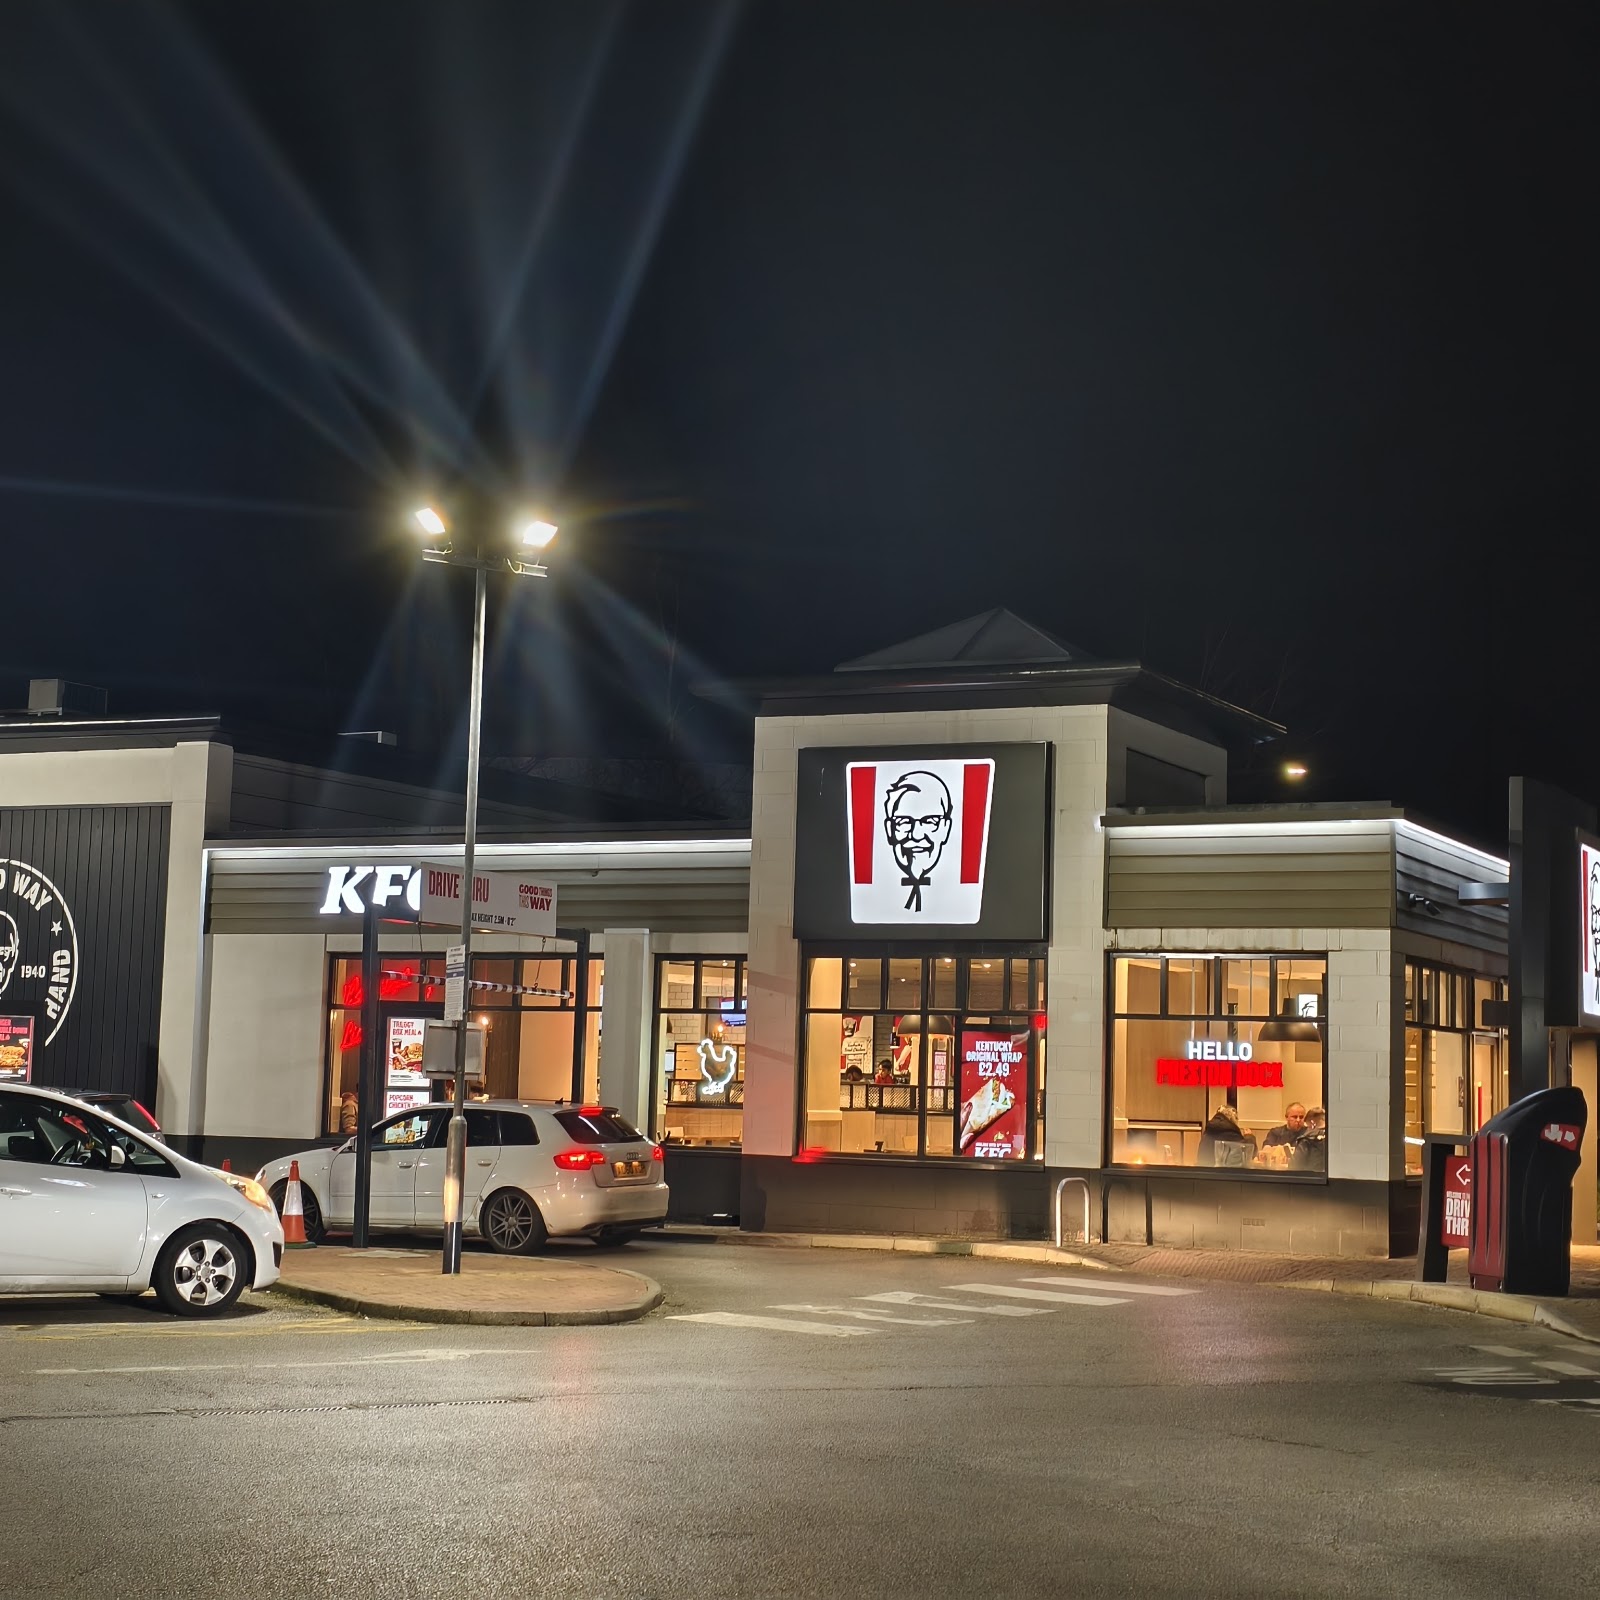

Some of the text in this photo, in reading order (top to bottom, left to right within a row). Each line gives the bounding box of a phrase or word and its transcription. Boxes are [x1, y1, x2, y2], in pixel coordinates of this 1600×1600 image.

[12, 871, 53, 911] WAY
[428, 870, 490, 903] DRIVE RU
[518, 884, 539, 895] GOOD
[530, 897, 552, 911] WAY
[21, 965, 46, 979] 1940
[45, 949, 71, 1020] HAND
[975, 1040, 1013, 1052] KENTUCKY
[1187, 1040, 1253, 1061] HELLO
[965, 1051, 1023, 1063] ORIGINAL WRAP
[978, 1062, 1010, 1077] £2.49
[1157, 1058, 1284, 1088] PRESTON DOCK
[1445, 1198, 1471, 1218] DRIV
[1445, 1215, 1470, 1236] THR
